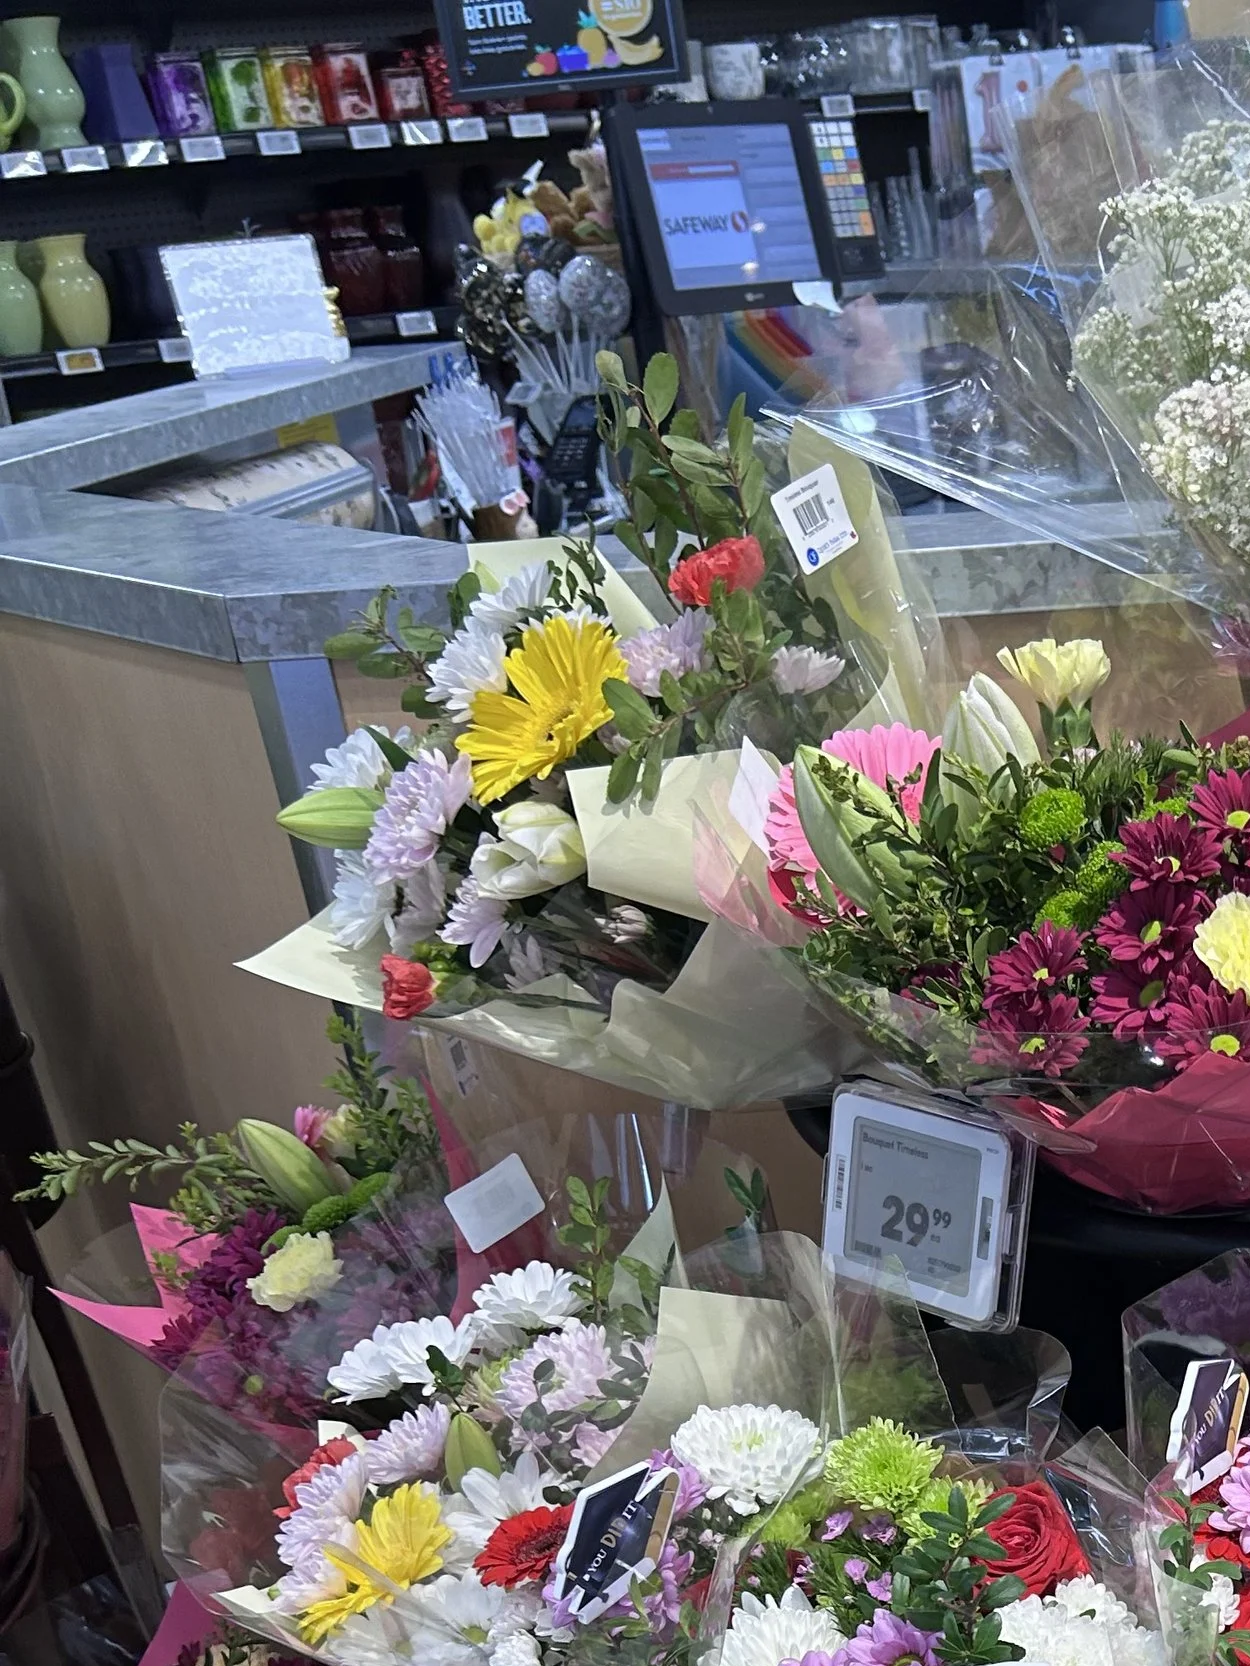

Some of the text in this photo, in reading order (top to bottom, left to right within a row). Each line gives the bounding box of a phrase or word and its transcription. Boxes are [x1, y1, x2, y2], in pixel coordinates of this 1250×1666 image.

[463, 1, 532, 30] BETTER.
[663, 215, 729, 236] SAFEWAY
[862, 1132, 896, 1153] Bouquet
[881, 1194, 952, 1247] 29 99
[588, 1500, 638, 1573] YOU DID IT
